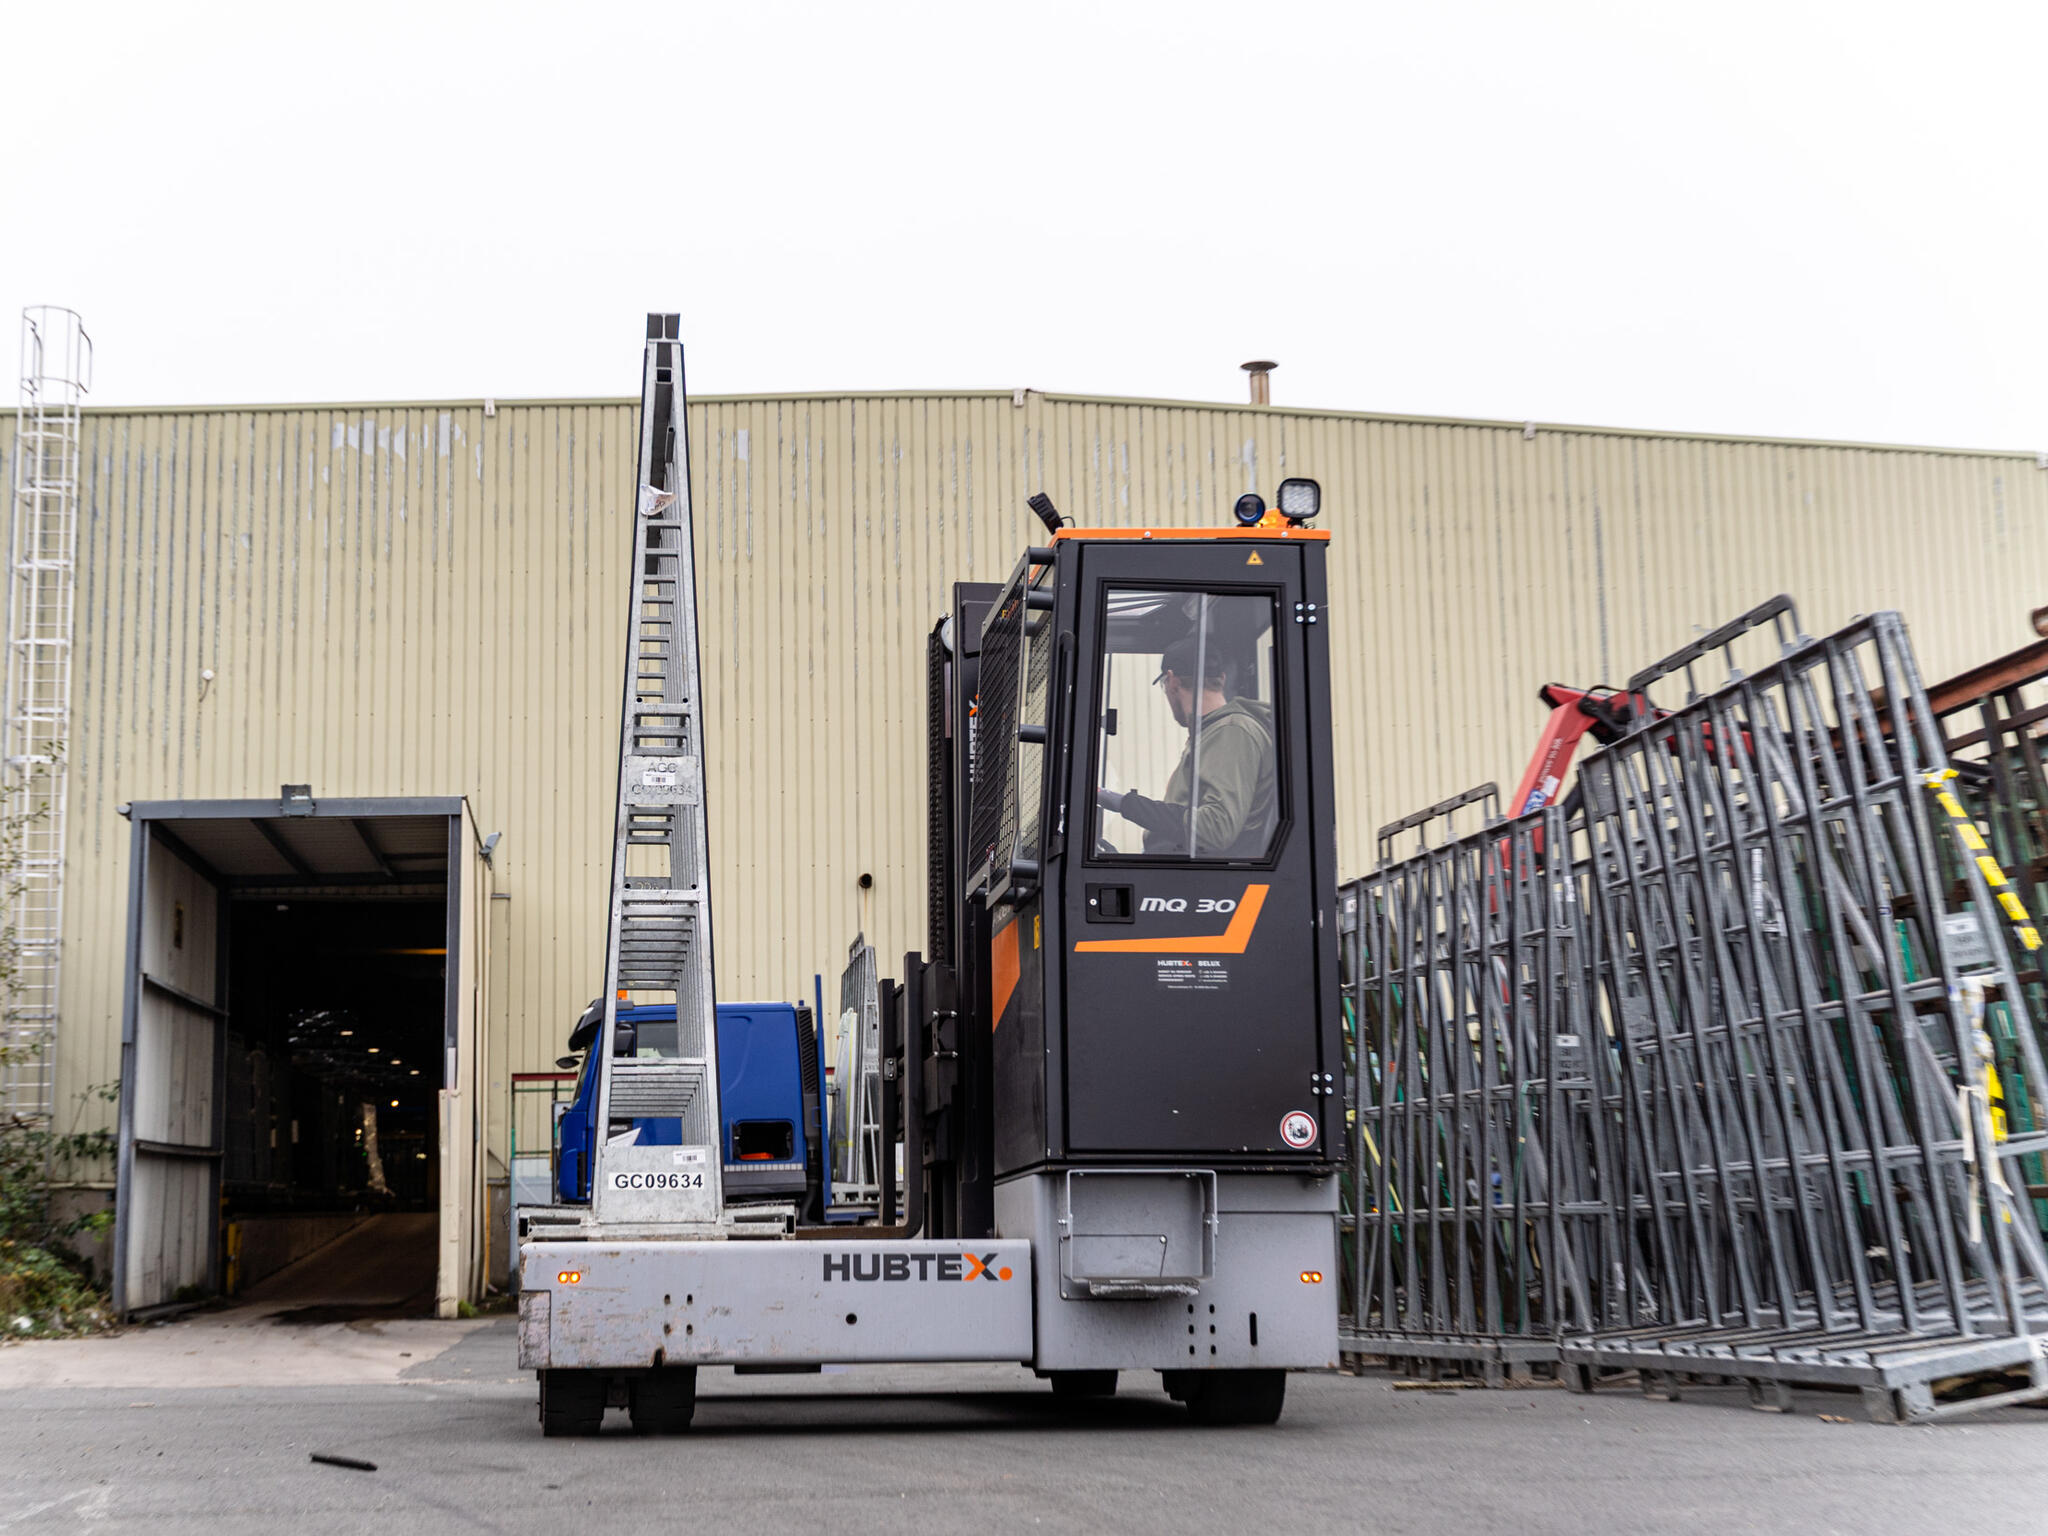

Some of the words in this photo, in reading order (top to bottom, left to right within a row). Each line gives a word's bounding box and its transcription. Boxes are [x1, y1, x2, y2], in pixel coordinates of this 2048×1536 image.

[1139, 897, 1187, 912] MQ
[1195, 898, 1237, 913] 30
[615, 1173, 703, 1189] GC09634
